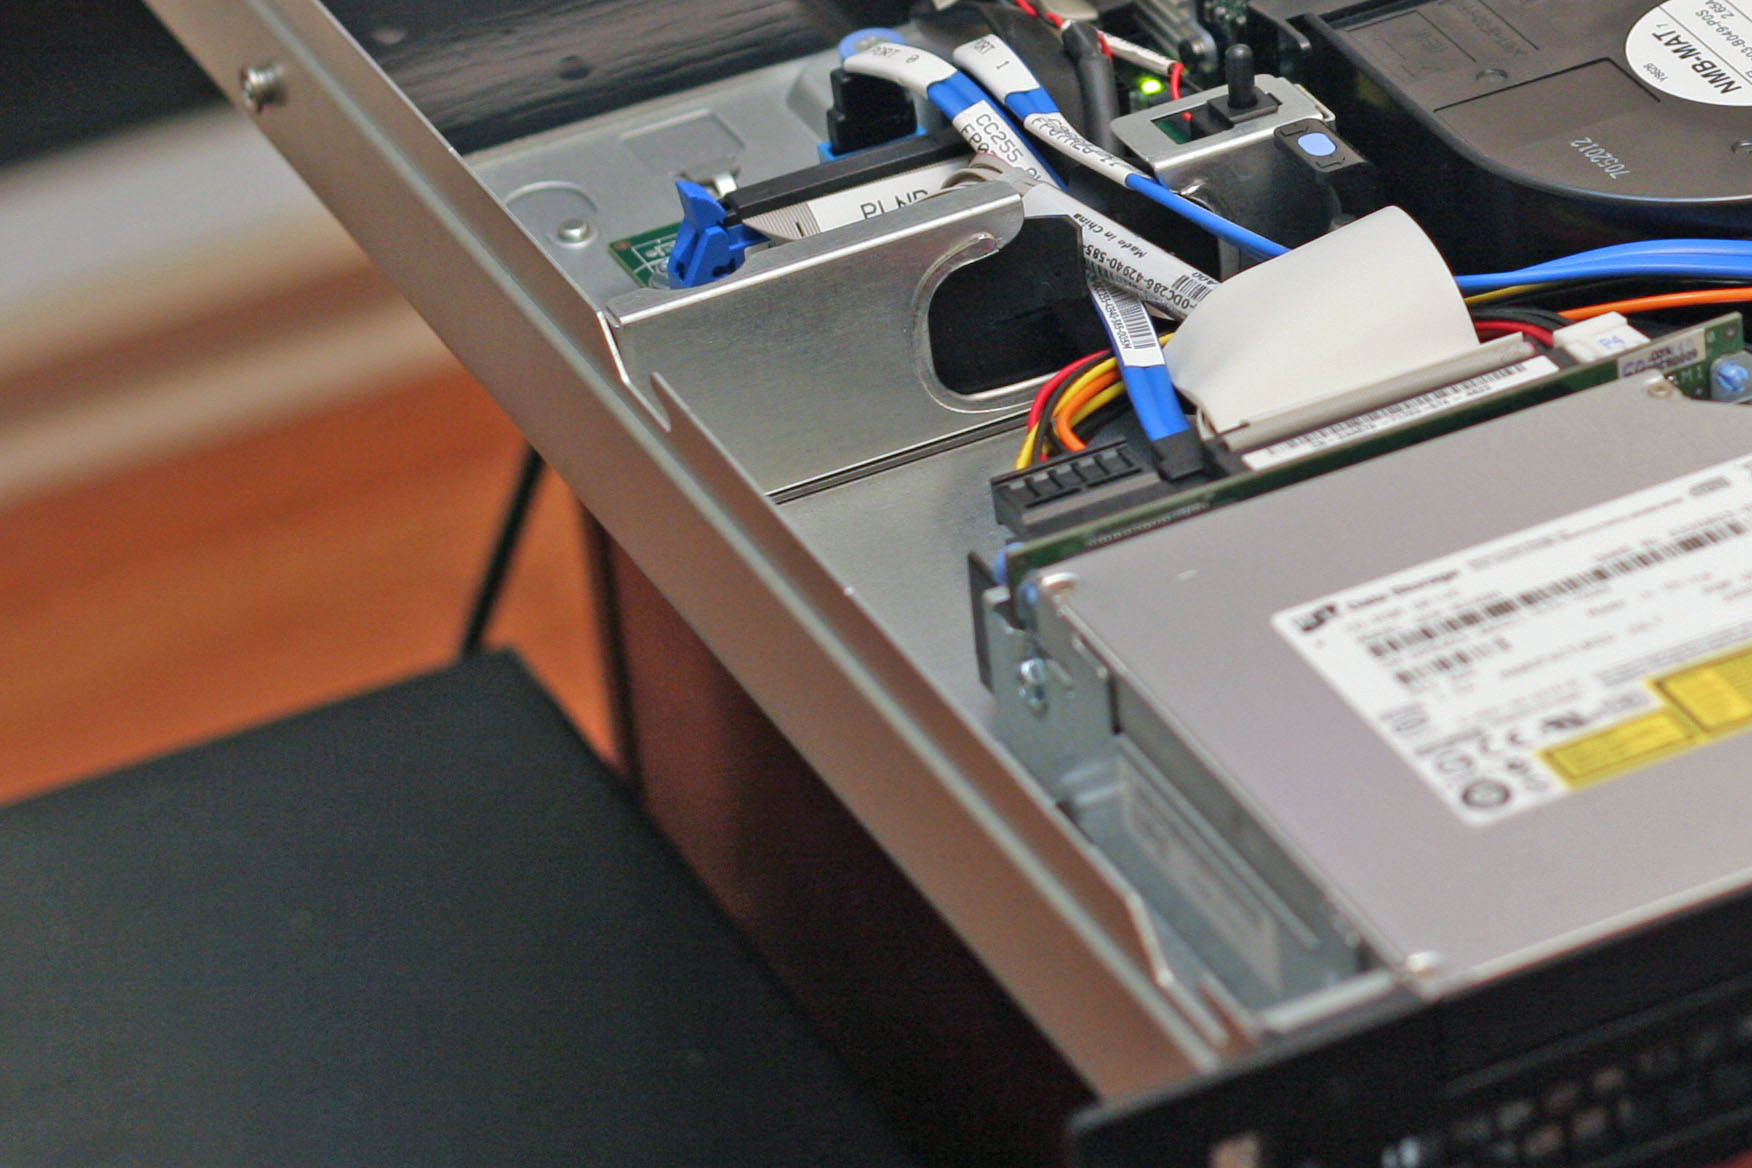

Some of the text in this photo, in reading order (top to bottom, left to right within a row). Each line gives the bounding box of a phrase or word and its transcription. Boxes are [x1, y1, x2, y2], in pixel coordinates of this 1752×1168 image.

[1650, 29, 1743, 93] NMB-MAT
[976, 113, 1024, 162] CC255
[1570, 136, 1631, 180] 7052012
[1073, 213, 1148, 259] Made in China
